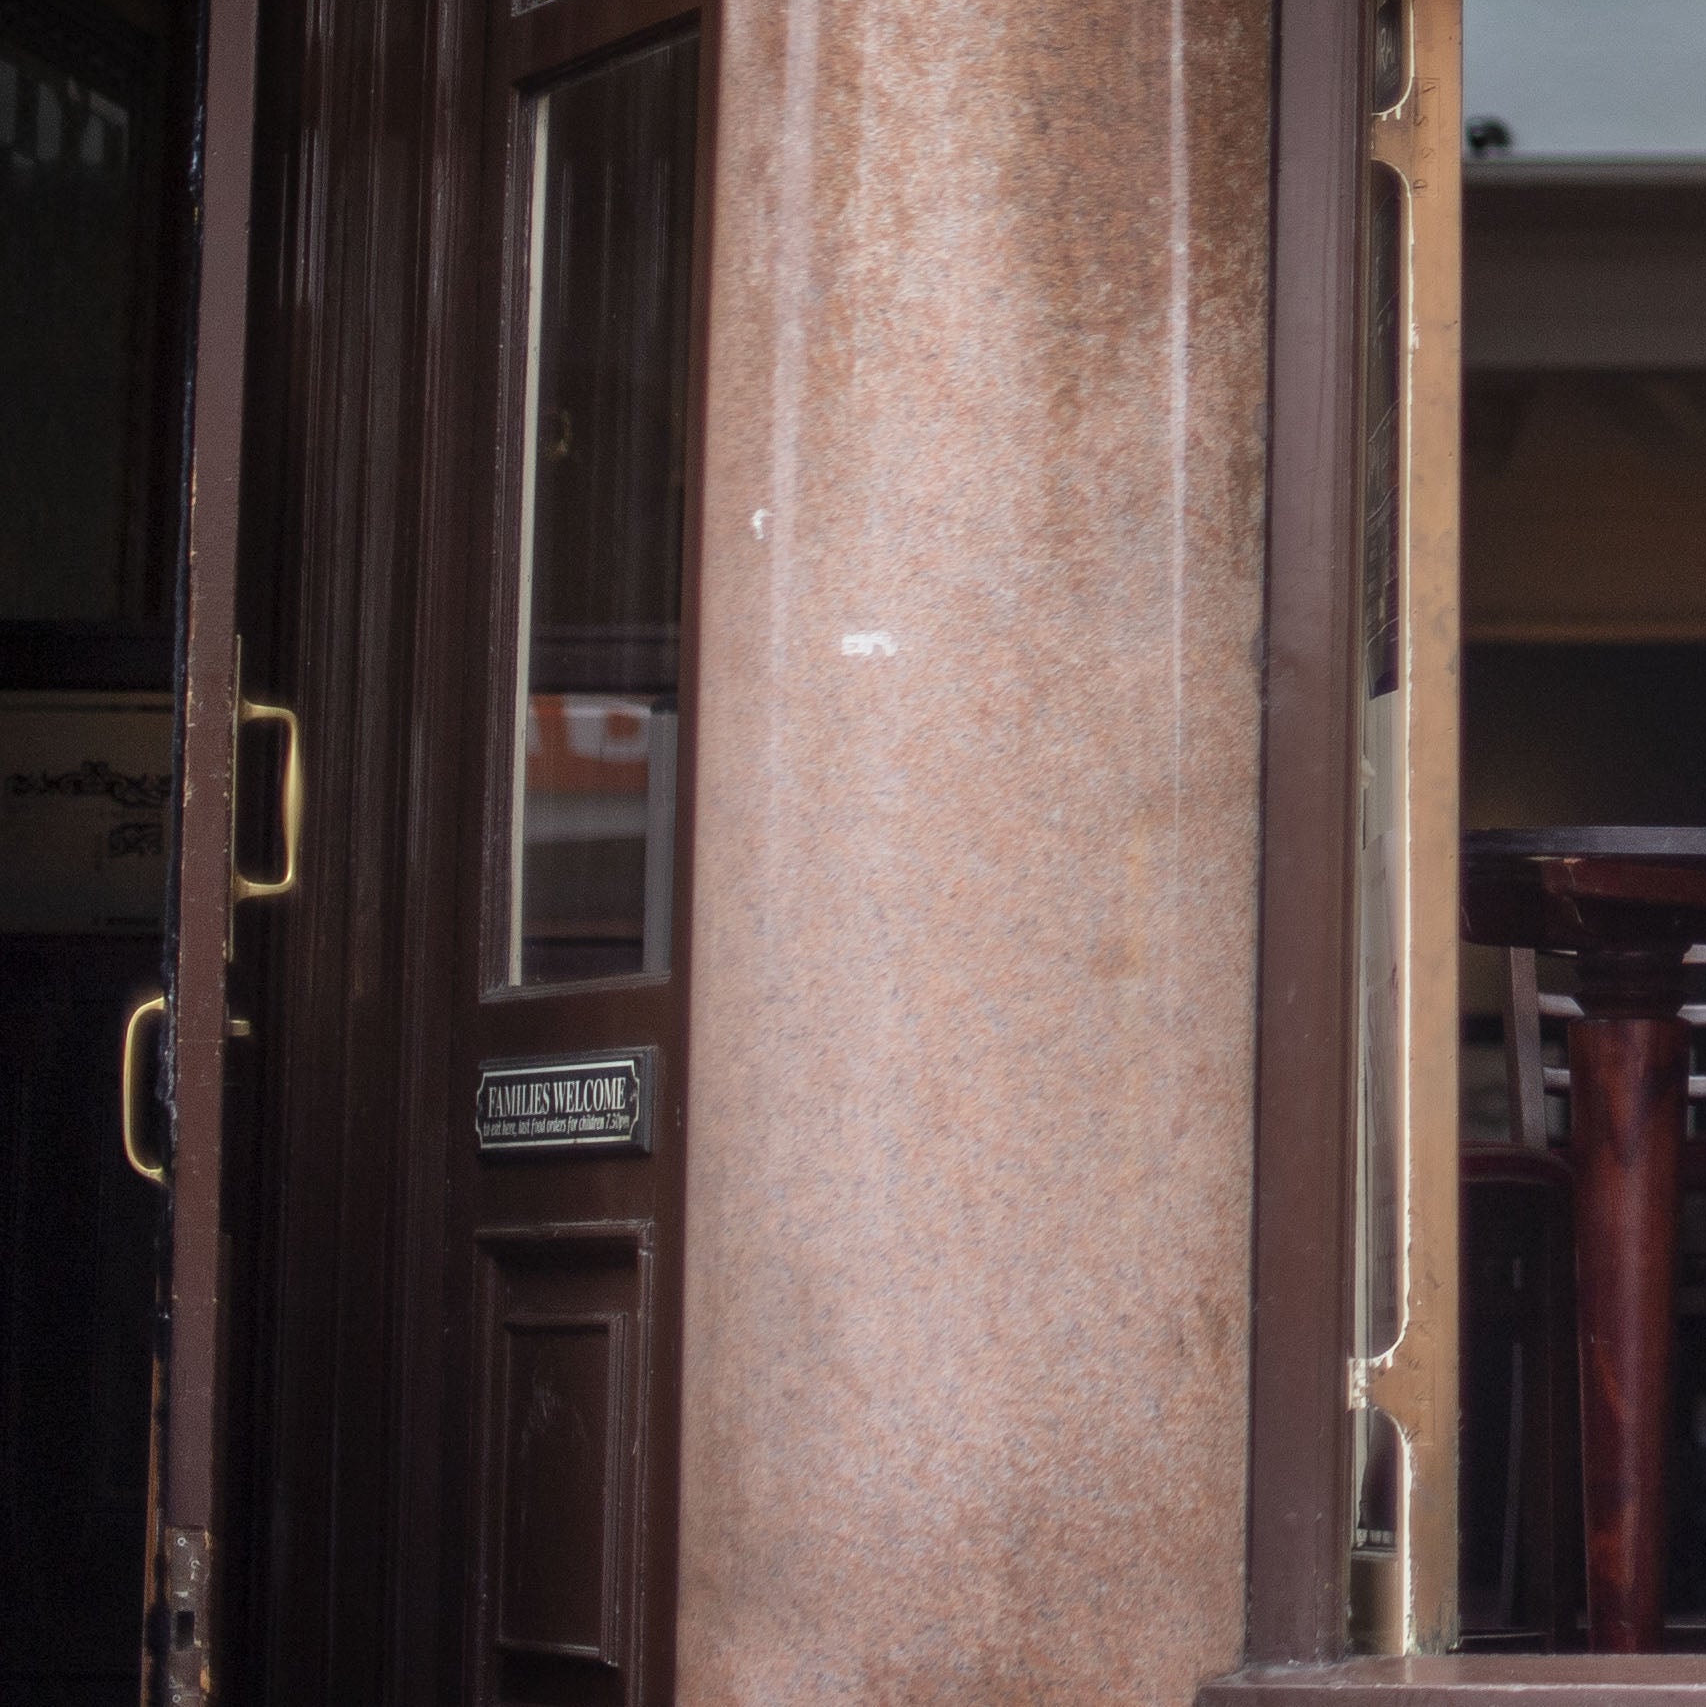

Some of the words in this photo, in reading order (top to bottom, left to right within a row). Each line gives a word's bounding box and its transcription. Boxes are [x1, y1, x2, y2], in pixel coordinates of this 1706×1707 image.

[488, 1082, 551, 1118] FAMILIES
[554, 1077, 626, 1113] WELCOME
[491, 1121, 502, 1136] eat
[518, 1119, 531, 1135] last
[530, 1117, 546, 1135] food
[546, 1117, 567, 1133] orders
[566, 1115, 578, 1134] for
[578, 1114, 605, 1131] children
